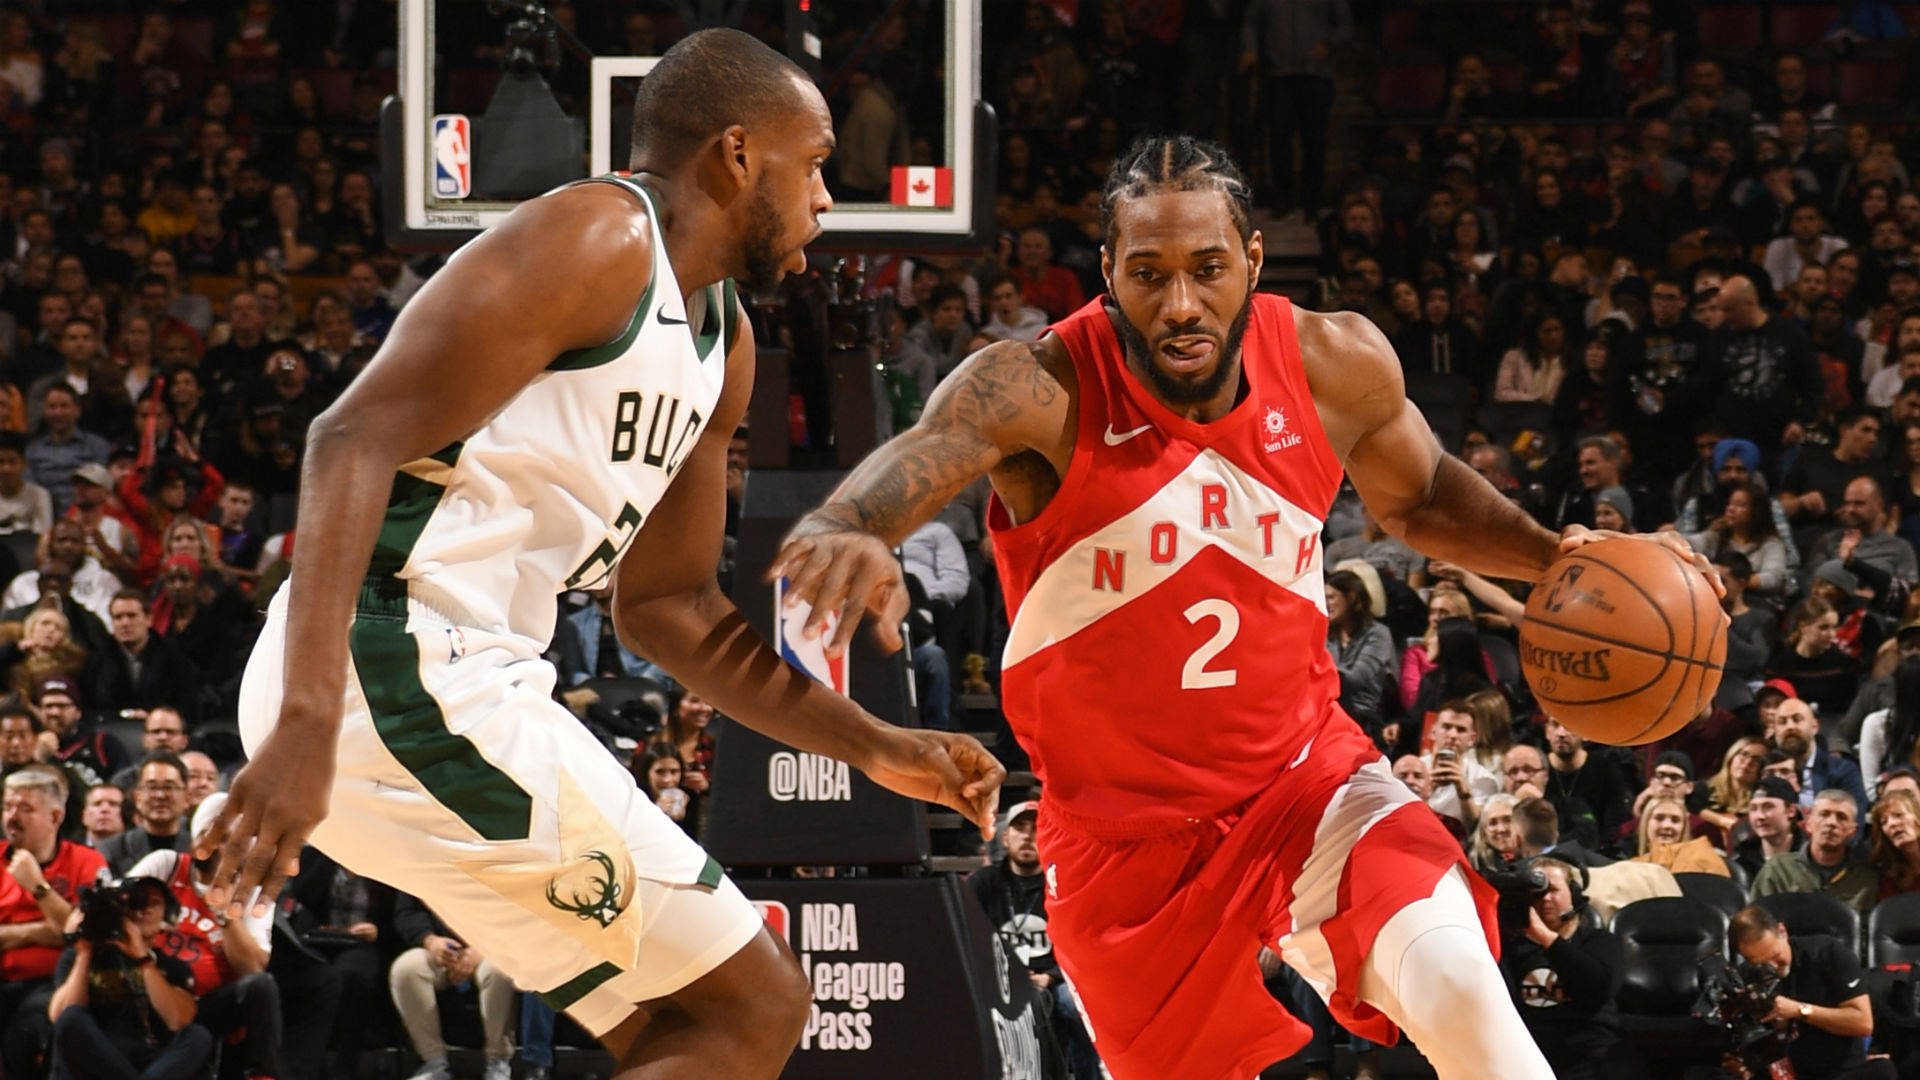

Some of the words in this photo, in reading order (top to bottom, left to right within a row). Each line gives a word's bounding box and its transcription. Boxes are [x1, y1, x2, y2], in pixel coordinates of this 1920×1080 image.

[1264, 442, 1281, 454] Sun
[1282, 431, 1302, 449] Life
[1181, 598, 1240, 690] 2
[769, 751, 851, 802] @NBA
[801, 903, 859, 952] NBA
[801, 1003, 873, 1051] Pass
